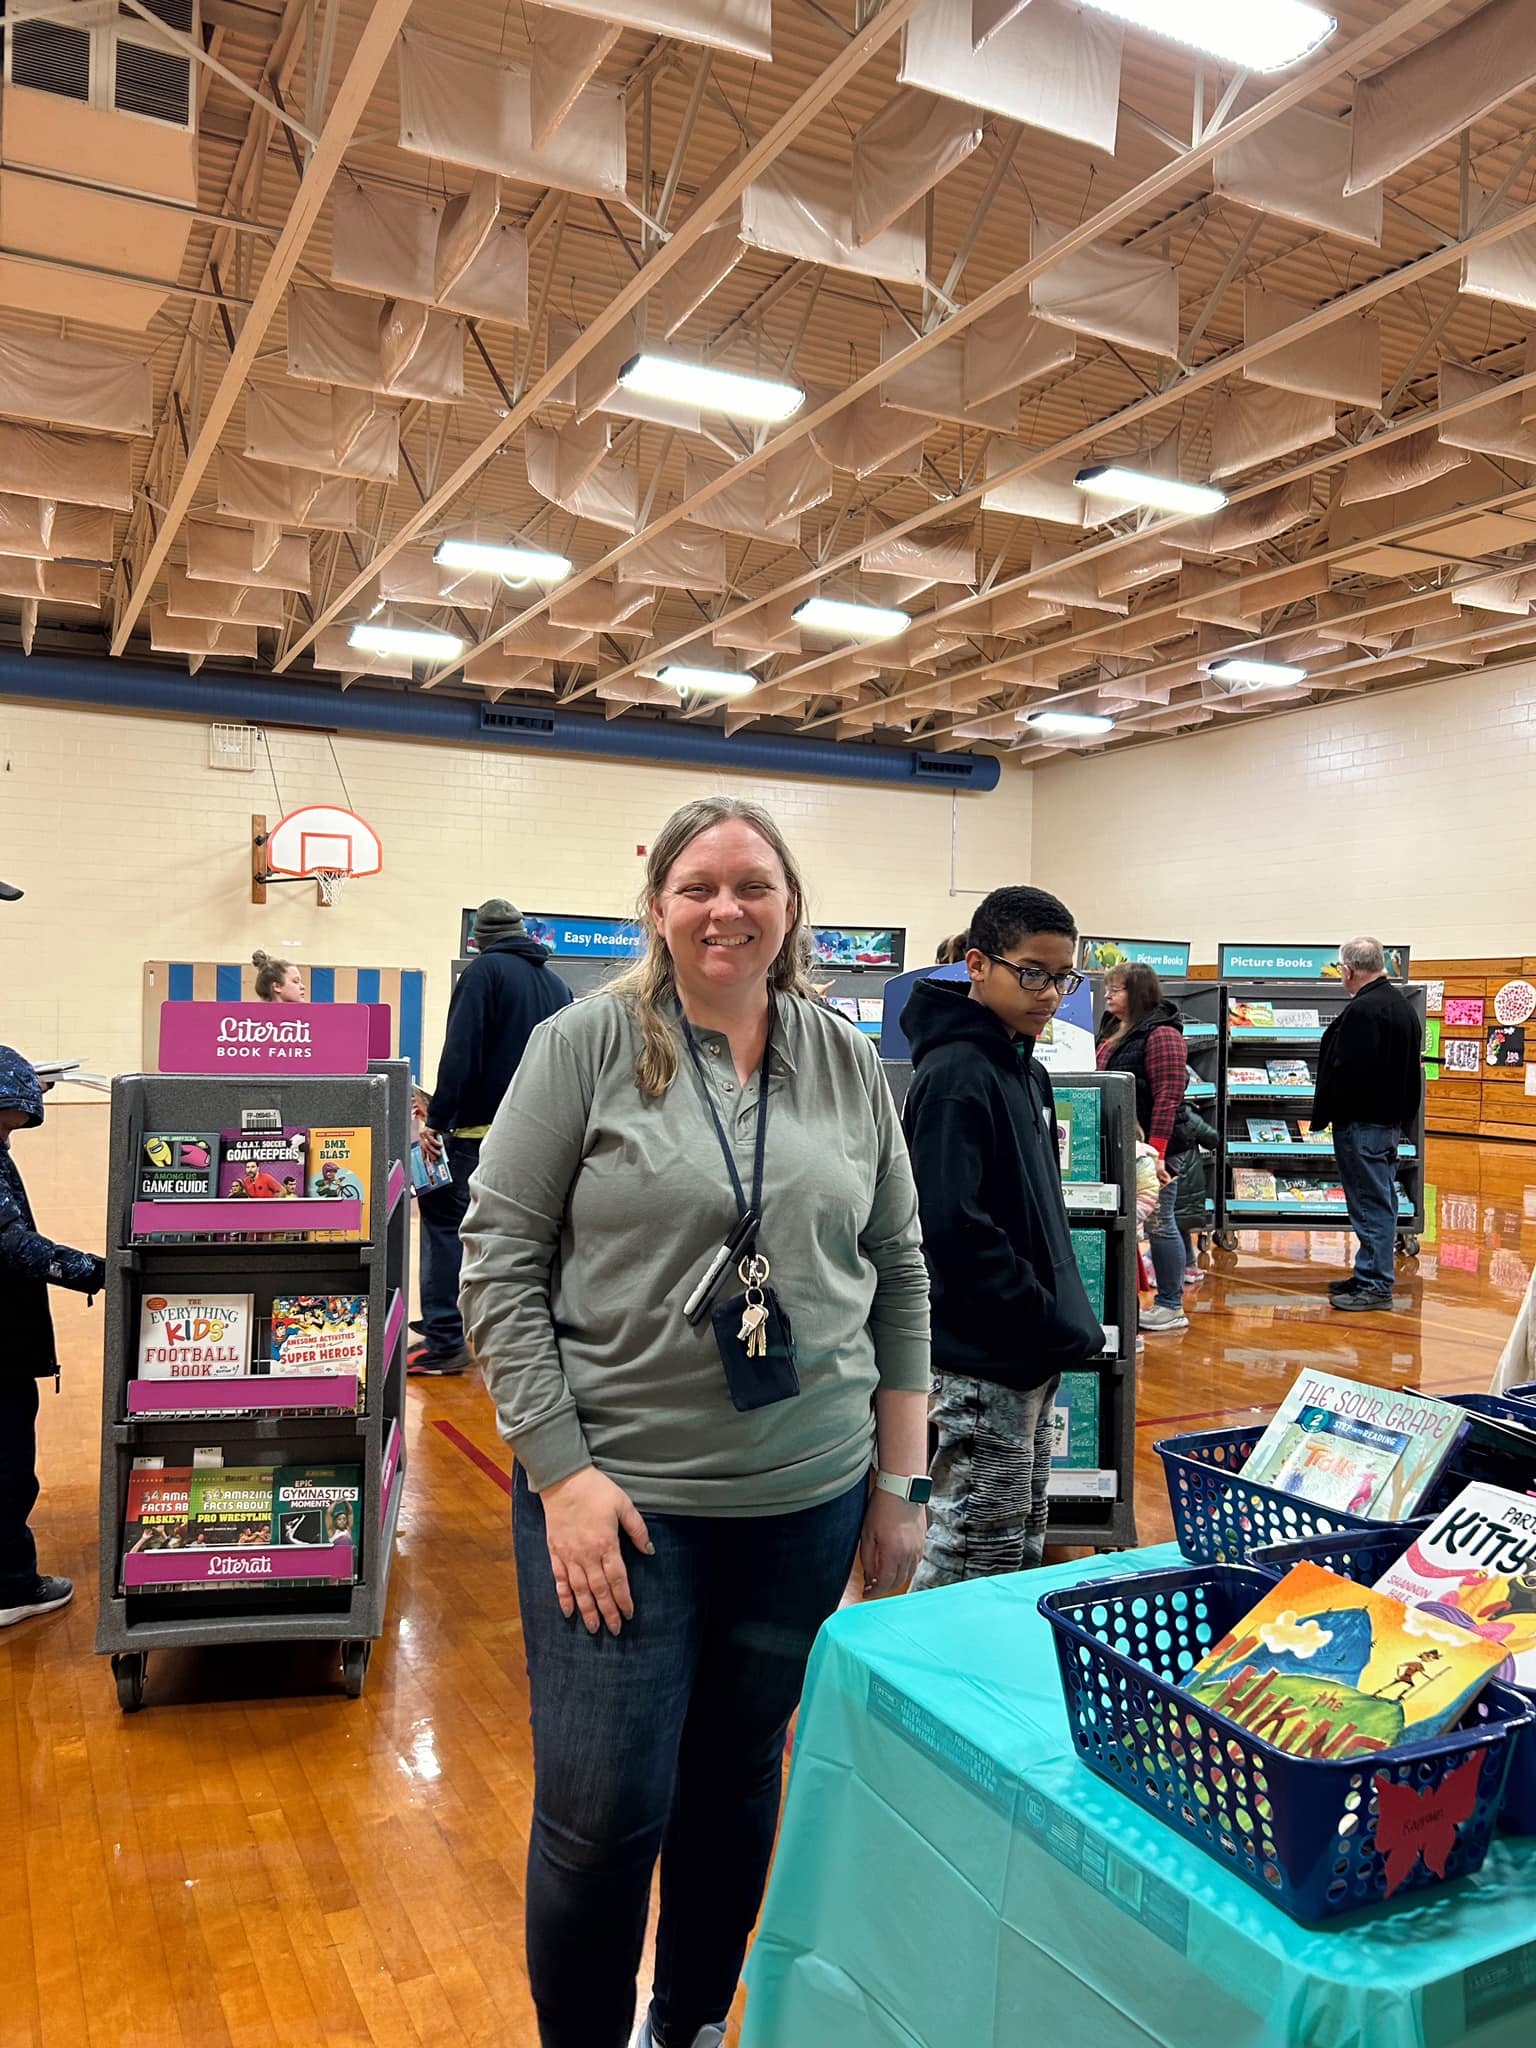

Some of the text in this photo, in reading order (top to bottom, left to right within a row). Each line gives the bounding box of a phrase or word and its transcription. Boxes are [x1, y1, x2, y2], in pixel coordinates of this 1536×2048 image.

[564, 931, 640, 947] Easy Readers
[1137, 953, 1183, 966] Picture Books
[1231, 957, 1313, 968] Picture Books
[217, 1017, 312, 1043] Literati
[217, 1047, 312, 1058] BOOK FAIRS
[262, 1140, 287, 1148] SOCCER
[320, 1150, 351, 1159] BLAST
[142, 1179, 208, 1193] GAME GUIDE
[151, 1306, 239, 1325] EVERYTHING
[287, 1332, 355, 1347] AWESOME ACTIVITIES
[145, 1347, 239, 1363] FOOTBALL
[280, 1345, 364, 1365] SUPER HEROES
[171, 1364, 213, 1377] BOOK
[1299, 1379, 1453, 1440] THE SOUR GRAPE
[1309, 1414, 1323, 1427] 2
[1333, 1420, 1353, 1433] STEP
[1362, 1430, 1397, 1446] READING
[294, 1479, 313, 1488] EPIC
[223, 1490, 273, 1500] AMAZING
[282, 1488, 356, 1499] GYMNASTICS
[141, 1503, 173, 1513] FACTS
[203, 1501, 270, 1511] FACTS ABOUT
[290, 1499, 331, 1508] MOMENTS
[197, 1513, 217, 1523] PRO
[207, 1555, 273, 1575] Literati
[1386, 1574, 1433, 1600] SHANNON
[1310, 1691, 1344, 1713] the
